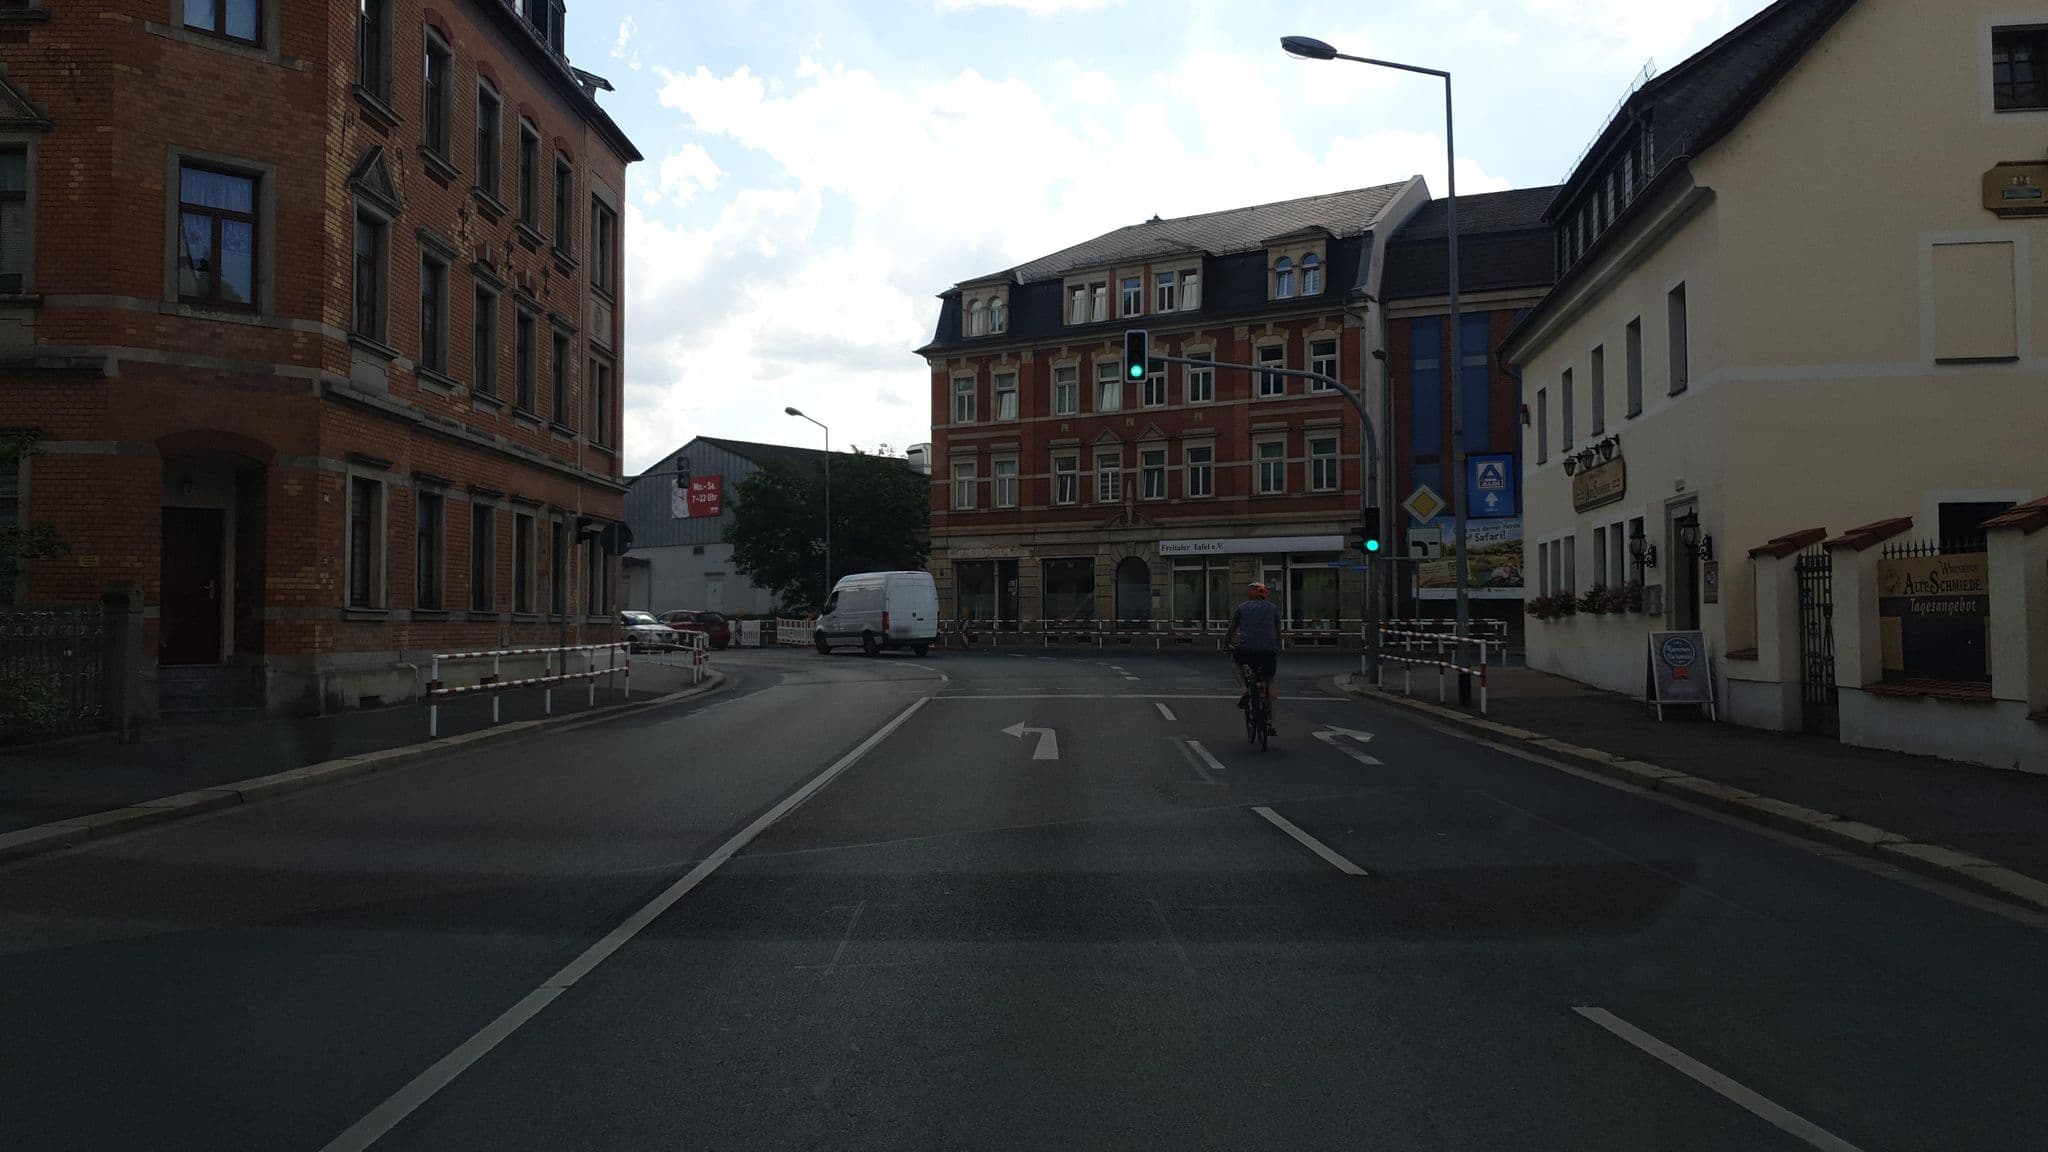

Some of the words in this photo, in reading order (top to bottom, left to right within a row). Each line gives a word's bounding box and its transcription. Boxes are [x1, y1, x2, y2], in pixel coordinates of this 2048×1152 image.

[707, 492, 718, 502] Uhr
[1474, 529, 1506, 542] Safari!
[1161, 543, 1191, 552] Freitaler
[1194, 543, 1210, 551] Tafel
[1211, 542, 1224, 551] e.V.
[1910, 596, 1977, 616] Tagesangebot
